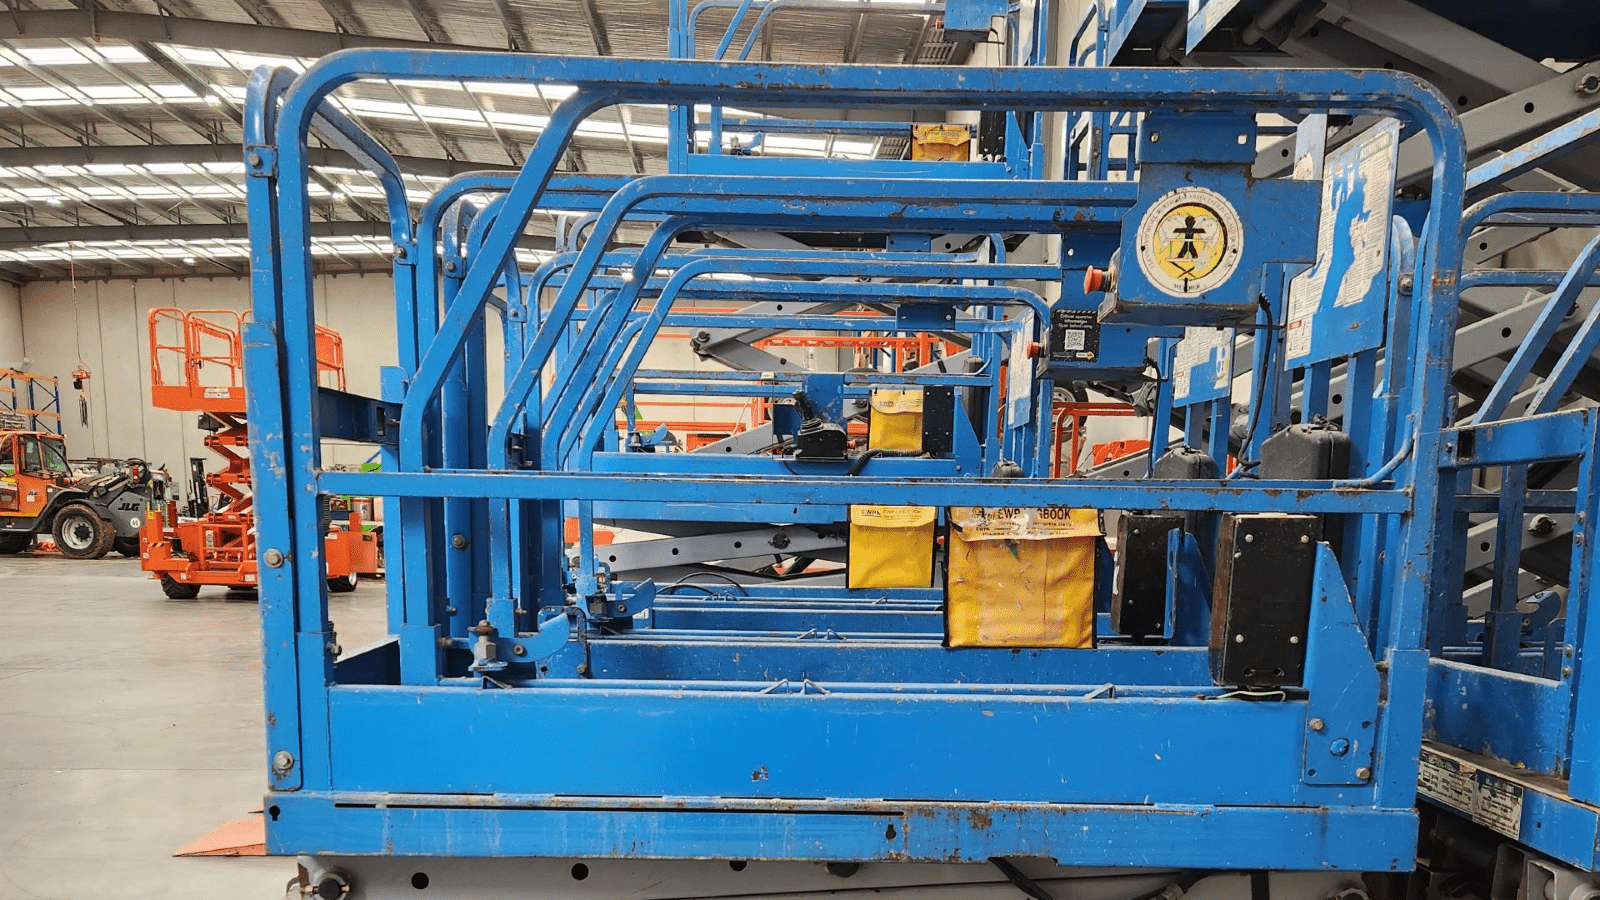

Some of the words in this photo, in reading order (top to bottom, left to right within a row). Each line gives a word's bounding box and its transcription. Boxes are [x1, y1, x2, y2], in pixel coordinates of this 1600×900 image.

[118, 503, 140, 512] JLG
[996, 508, 1021, 520] EWP
[1030, 508, 1071, 520] GBOOK
